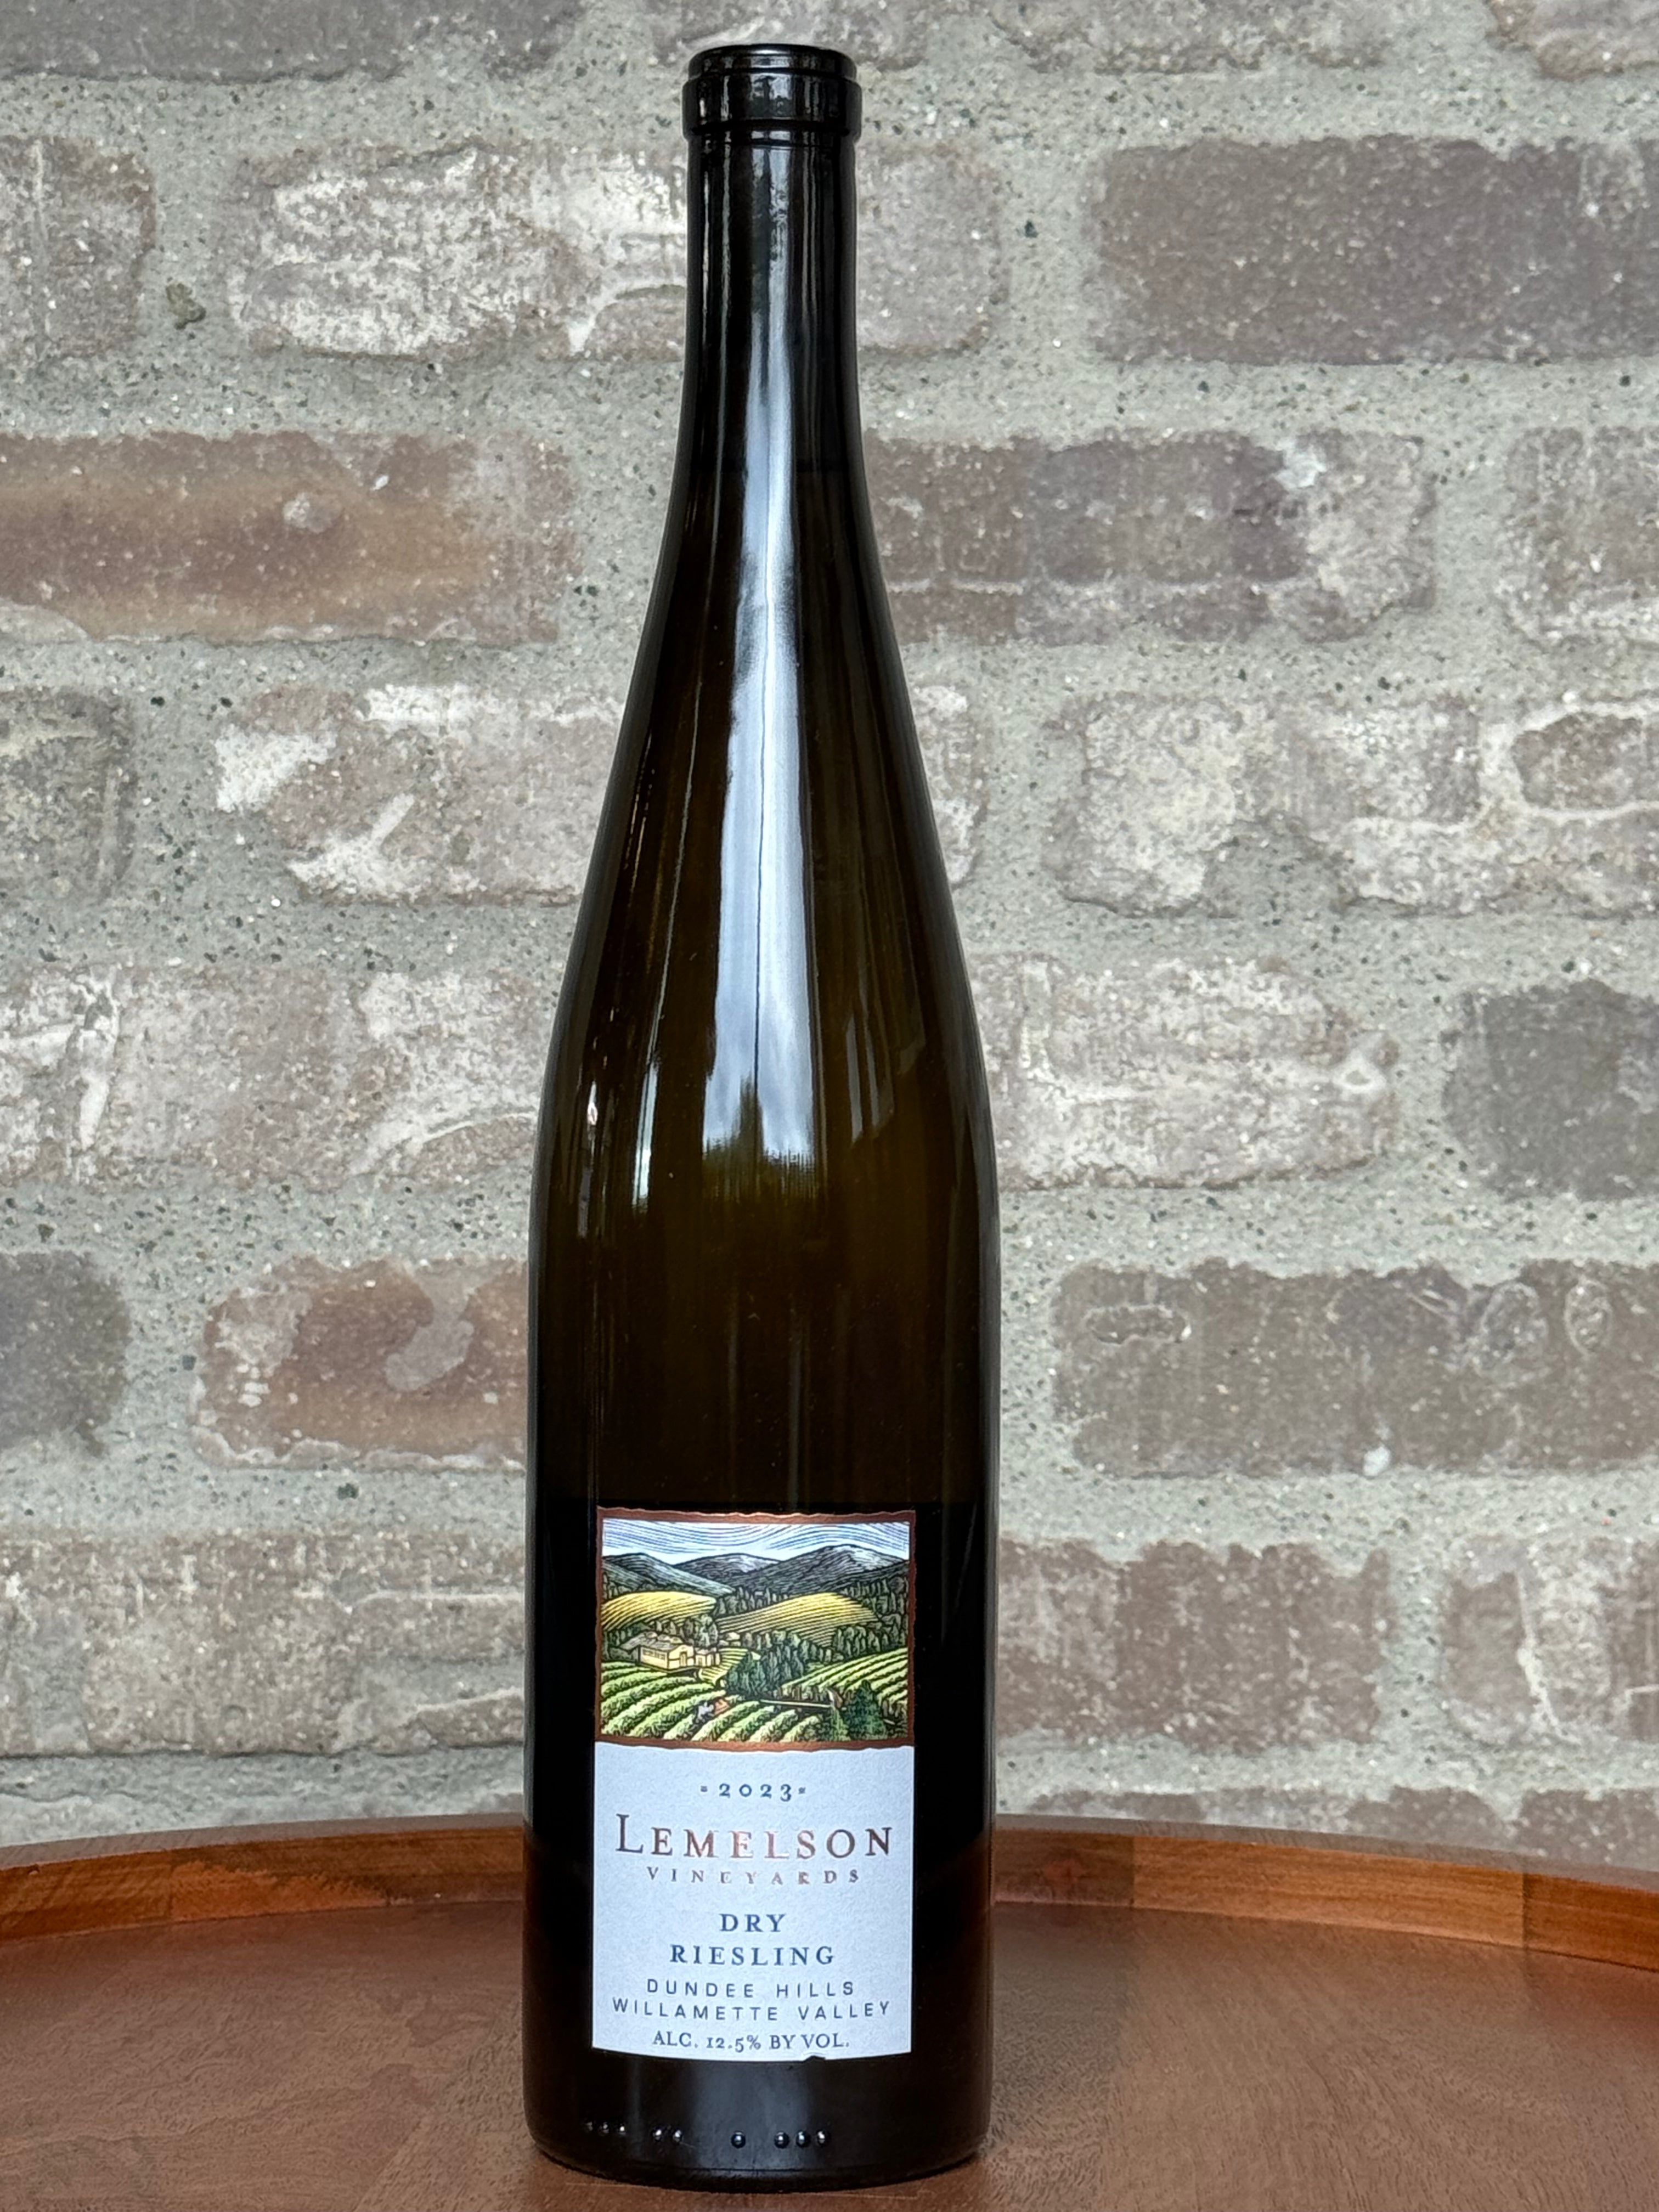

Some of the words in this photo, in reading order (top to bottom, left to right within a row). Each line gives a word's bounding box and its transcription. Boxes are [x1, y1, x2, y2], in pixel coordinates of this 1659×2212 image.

[616, 1814, 892, 1859] LEMELSON
[647, 1866, 860, 1885] VINEYARDS
[720, 1914, 786, 1932] DRY
[670, 1944, 835, 1965] RIESLING
[647, 1979, 754, 1998] DUNDEE
[777, 1981, 854, 1998] HILLS
[613, 1997, 778, 2021] WILLAMETTE
[798, 2001, 890, 2020] VALLEY
[652, 2030, 698, 2048] ALC.
[707, 2036, 761, 2052] 12.5%
[769, 2033, 794, 2049] BY
[800, 2033, 849, 2048] VOL.
